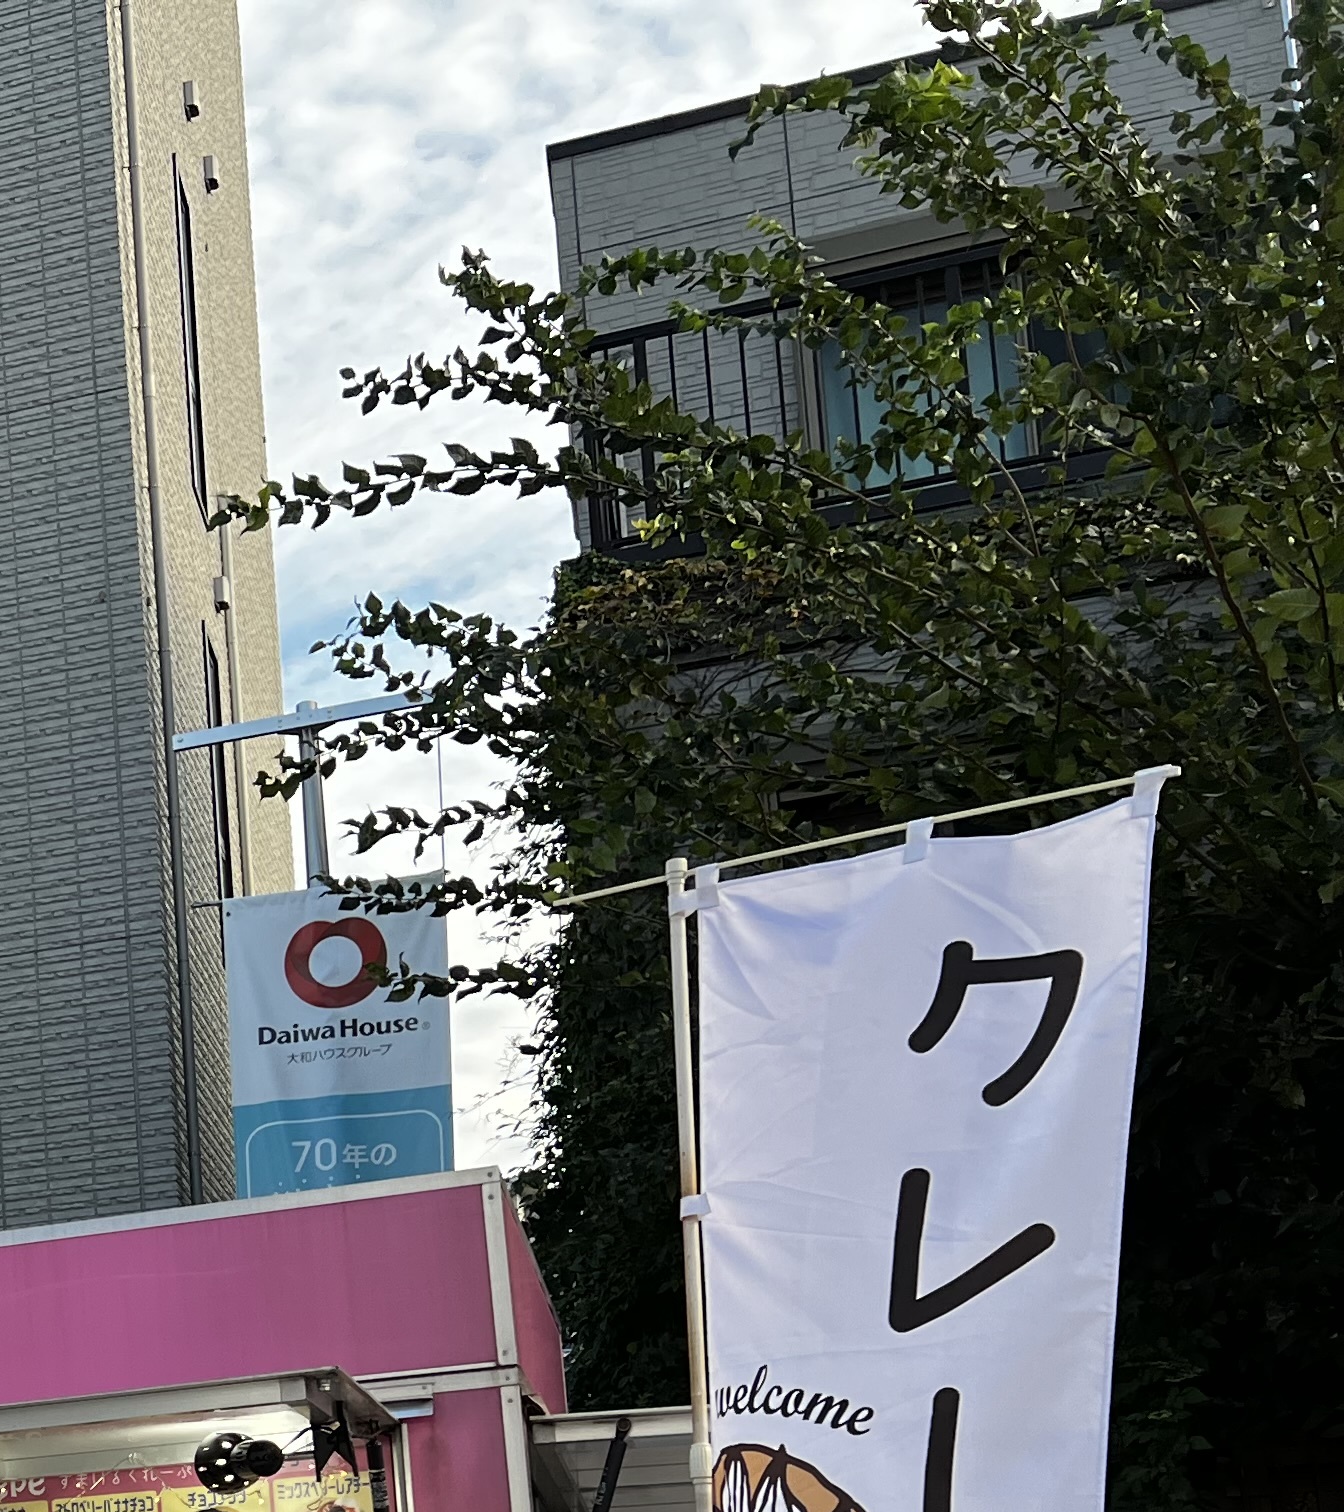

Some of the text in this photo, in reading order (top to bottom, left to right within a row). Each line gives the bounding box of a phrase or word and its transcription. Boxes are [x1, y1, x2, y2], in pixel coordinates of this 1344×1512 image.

[258, 1016, 419, 1046] Daiwa House
[287, 1043, 393, 1065] 大和ハウスグループ
[291, 1137, 397, 1173] 70年の
[715, 1364, 875, 1436] welcome
